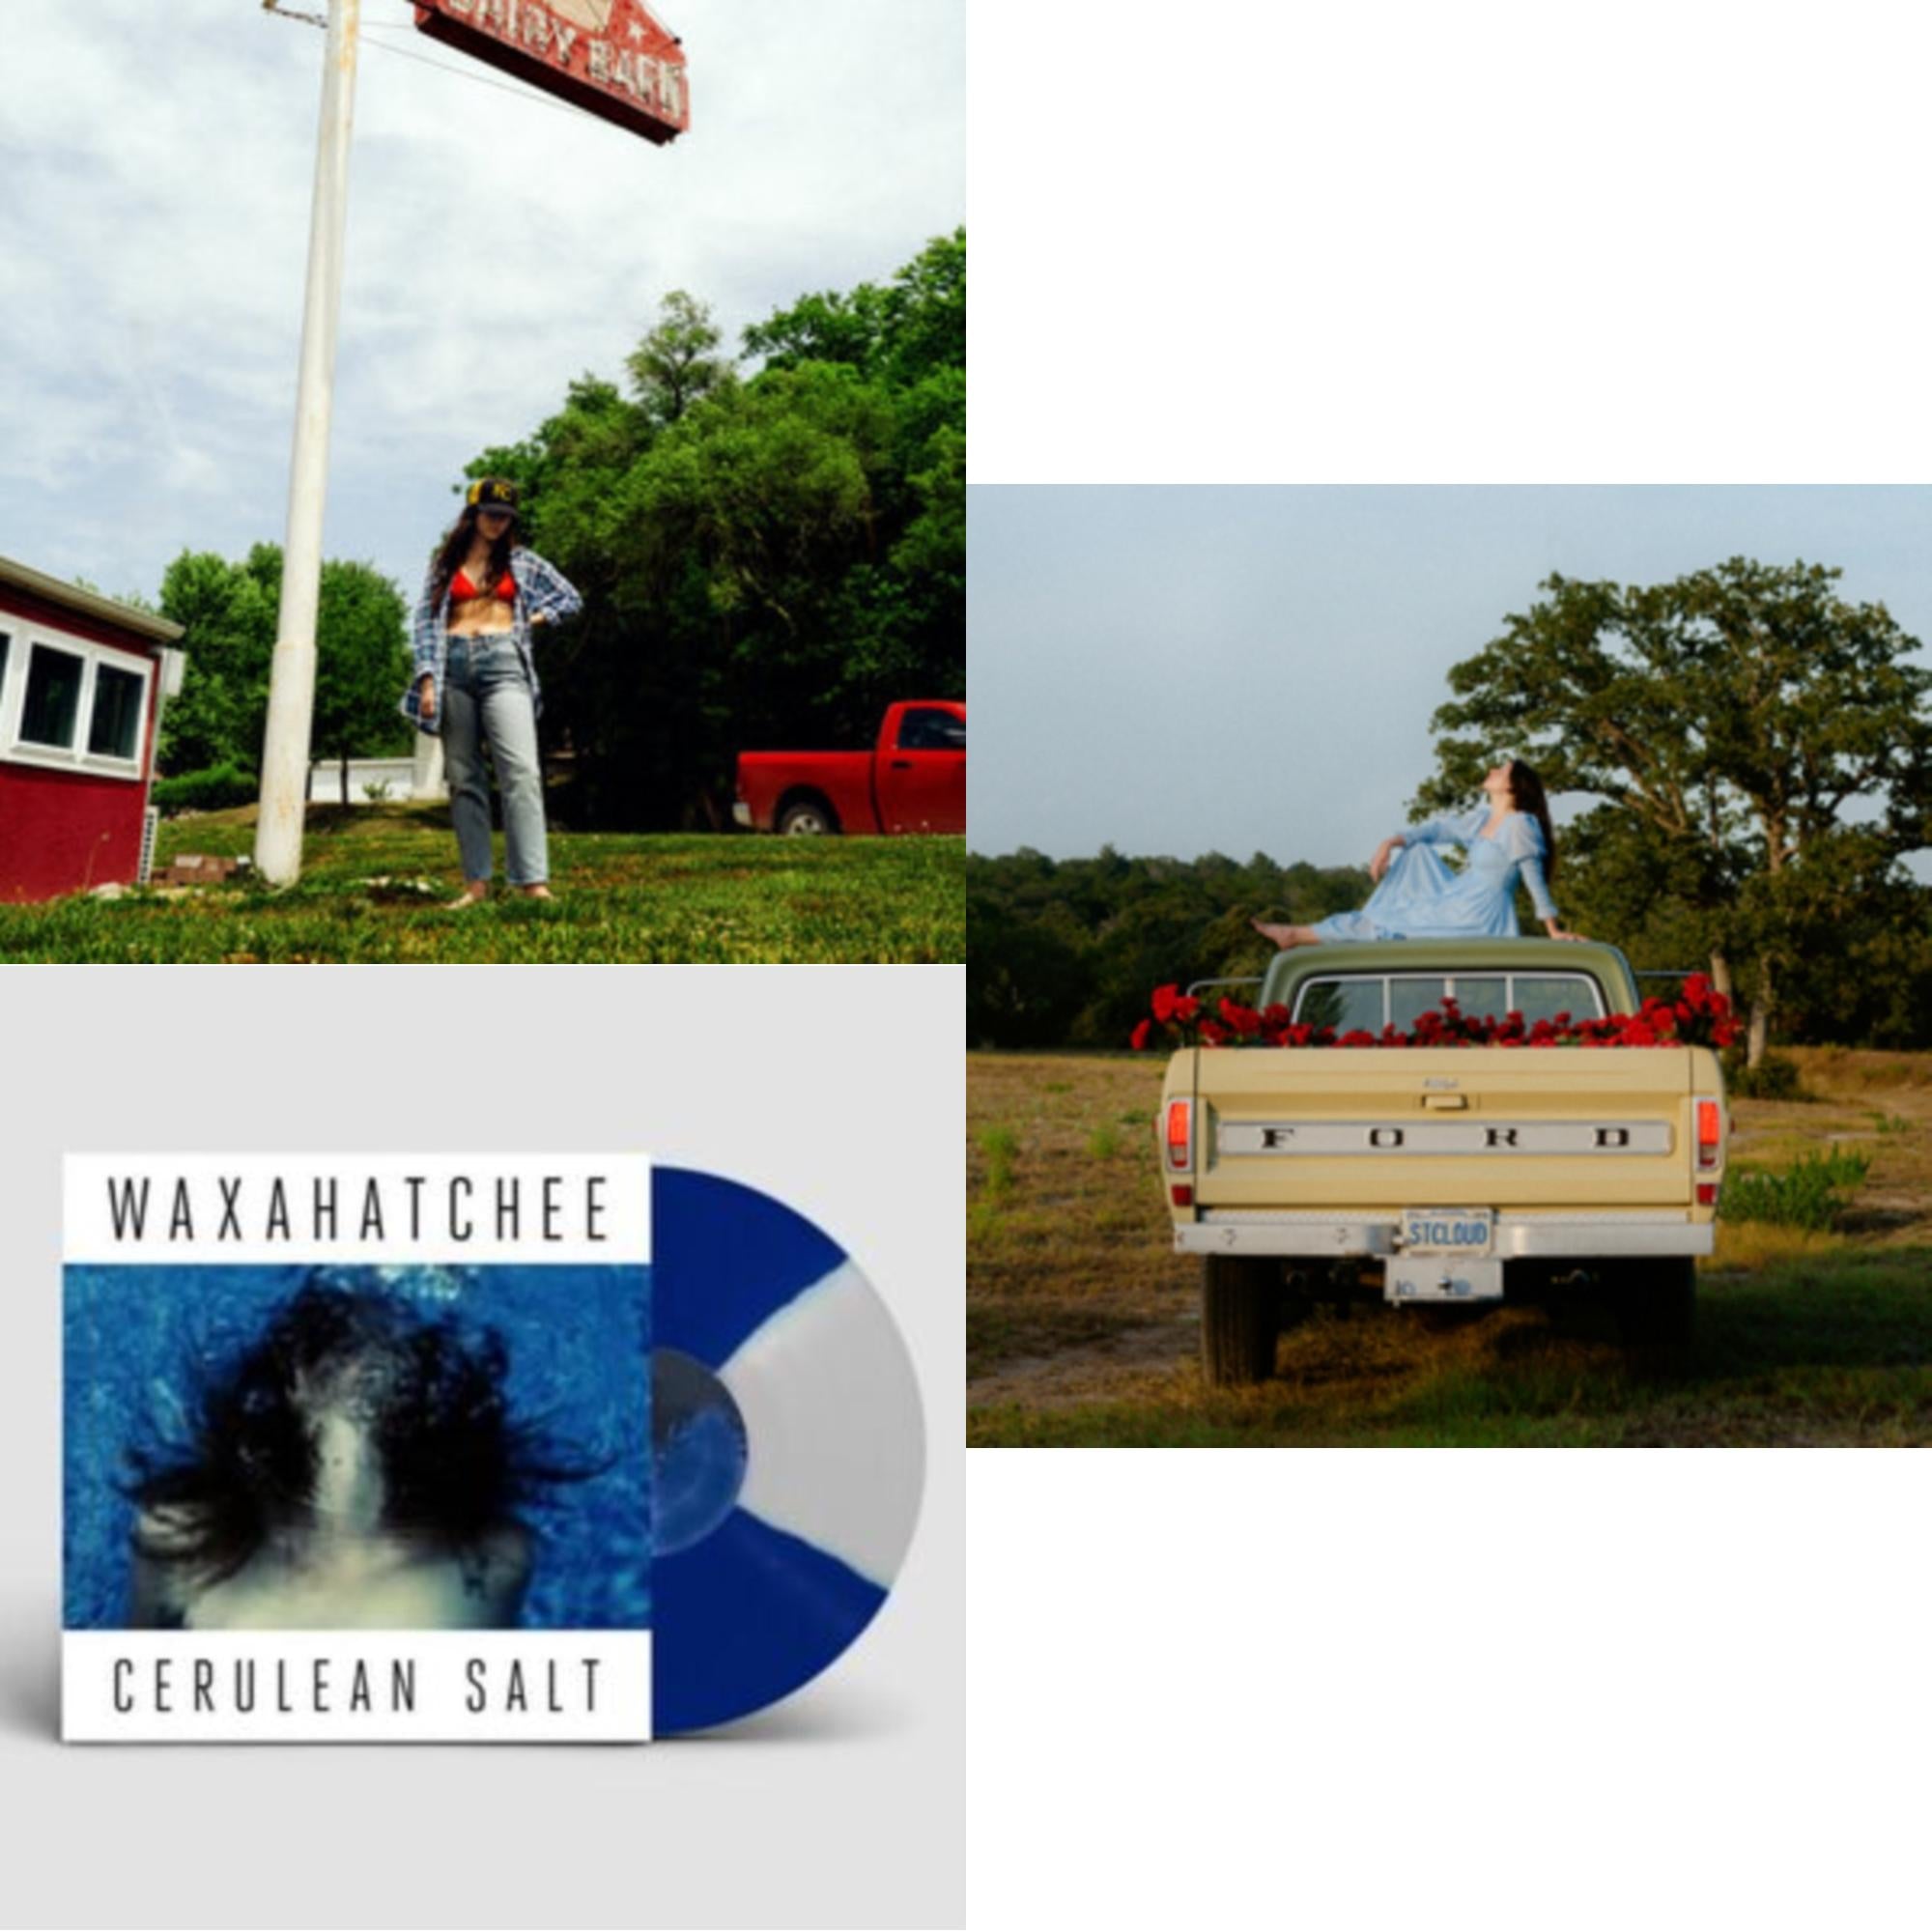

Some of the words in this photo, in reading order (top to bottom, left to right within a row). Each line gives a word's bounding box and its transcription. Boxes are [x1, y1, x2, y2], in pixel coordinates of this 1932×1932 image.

[588, 39, 681, 118] BARN
[1261, 1127, 1631, 1149] FORD
[107, 1176, 606, 1242] WAXAHATCHEE
[1409, 1221, 1488, 1244] STCLOUD
[113, 1658, 417, 1713] CERULEAN
[467, 1658, 600, 1713] SALT
